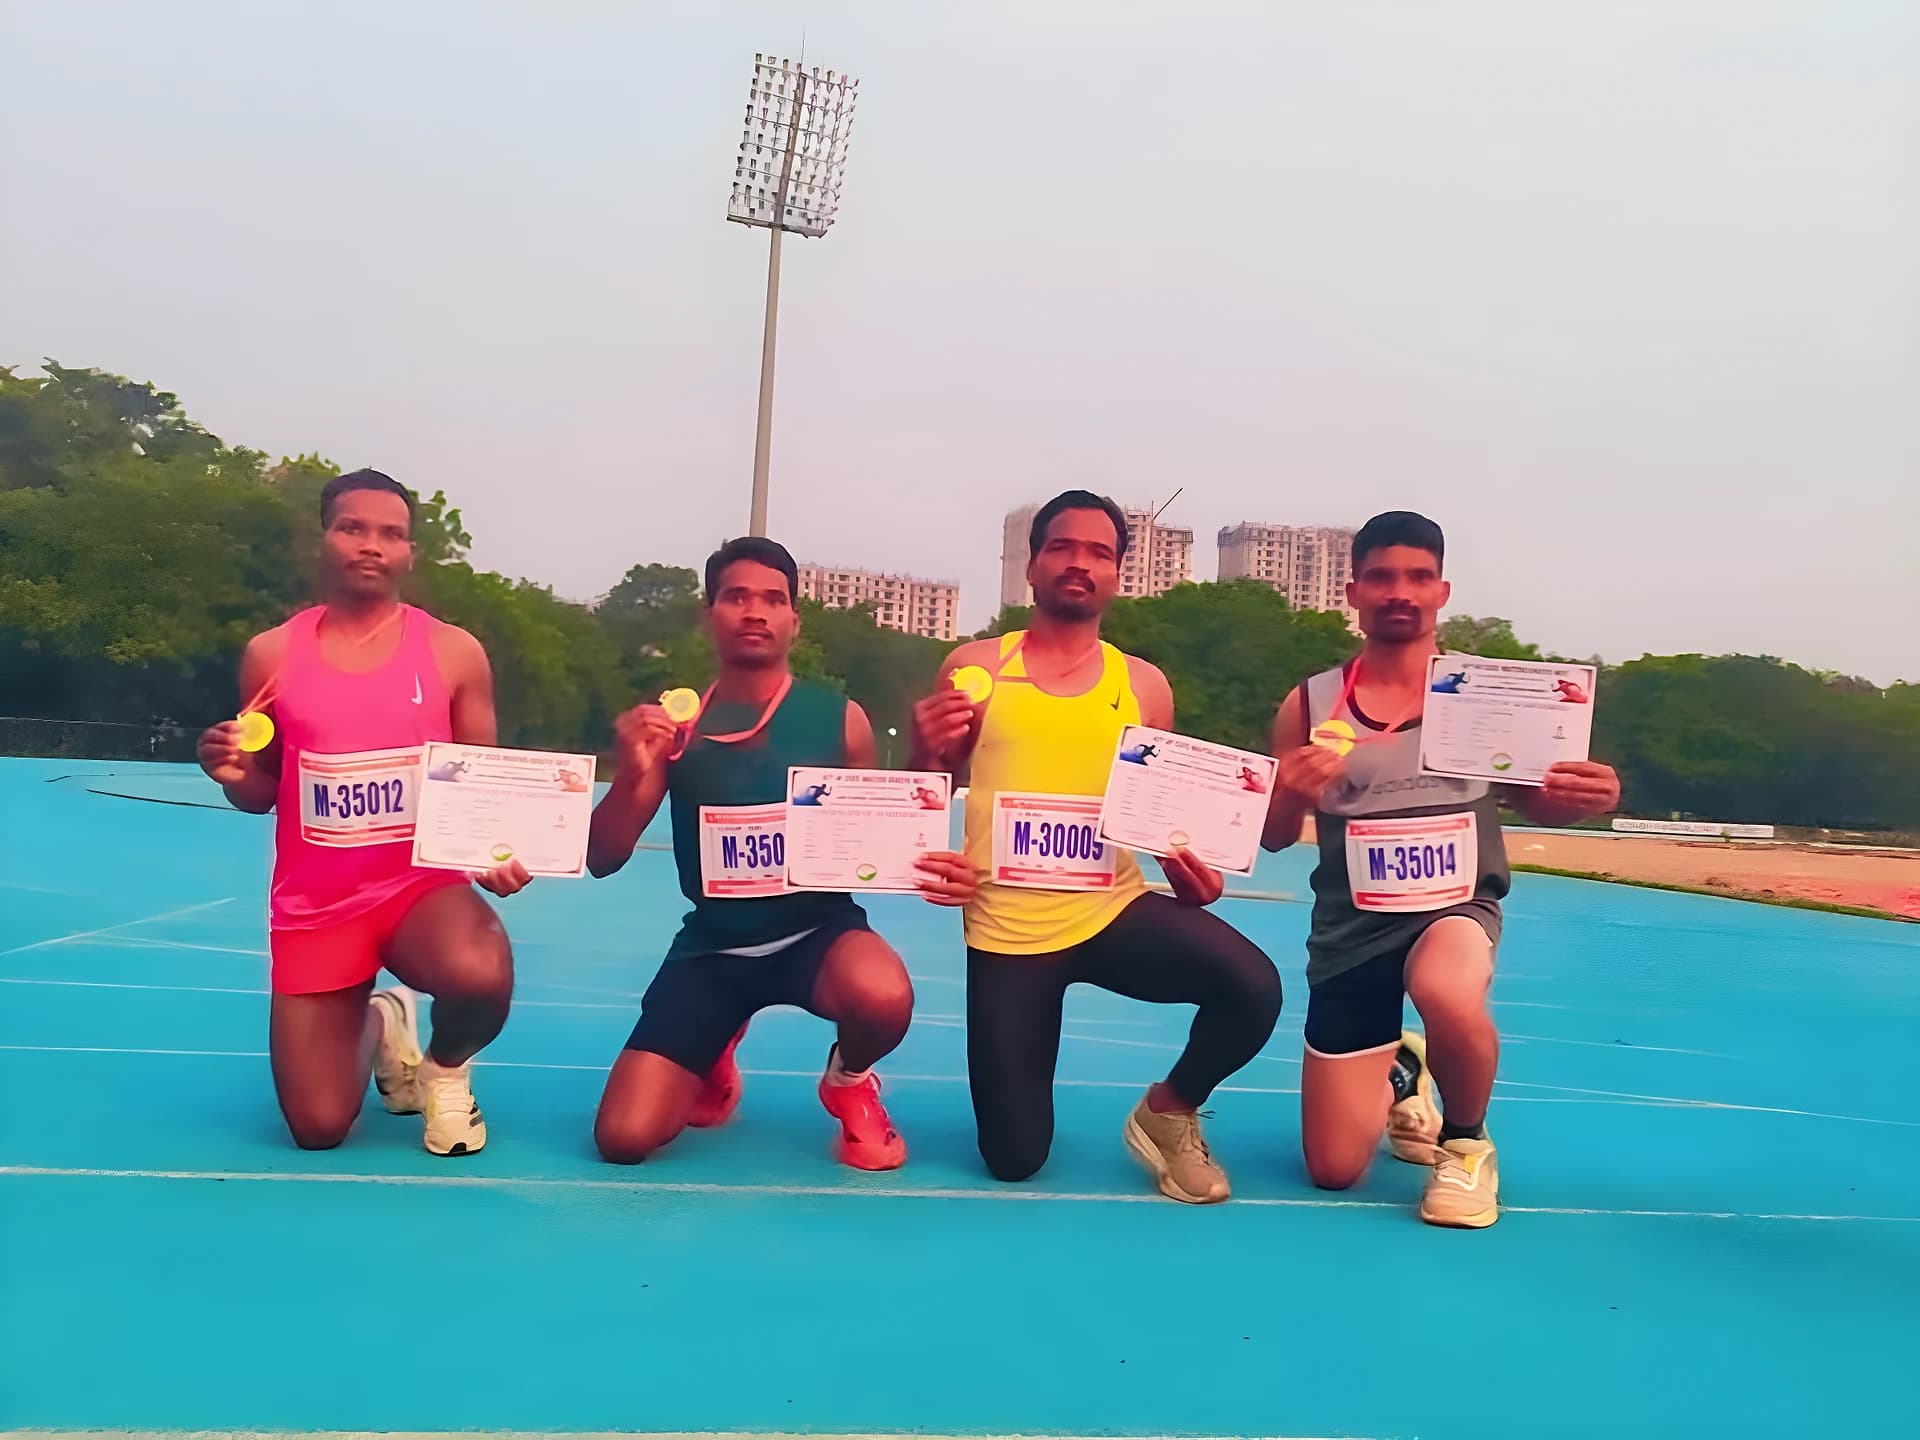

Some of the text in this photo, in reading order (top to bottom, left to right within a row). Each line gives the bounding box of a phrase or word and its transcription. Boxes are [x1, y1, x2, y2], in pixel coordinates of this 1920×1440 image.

[313, 779, 404, 819] M-35012
[722, 832, 785, 869] M-350
[1368, 842, 1456, 880] M-35014
